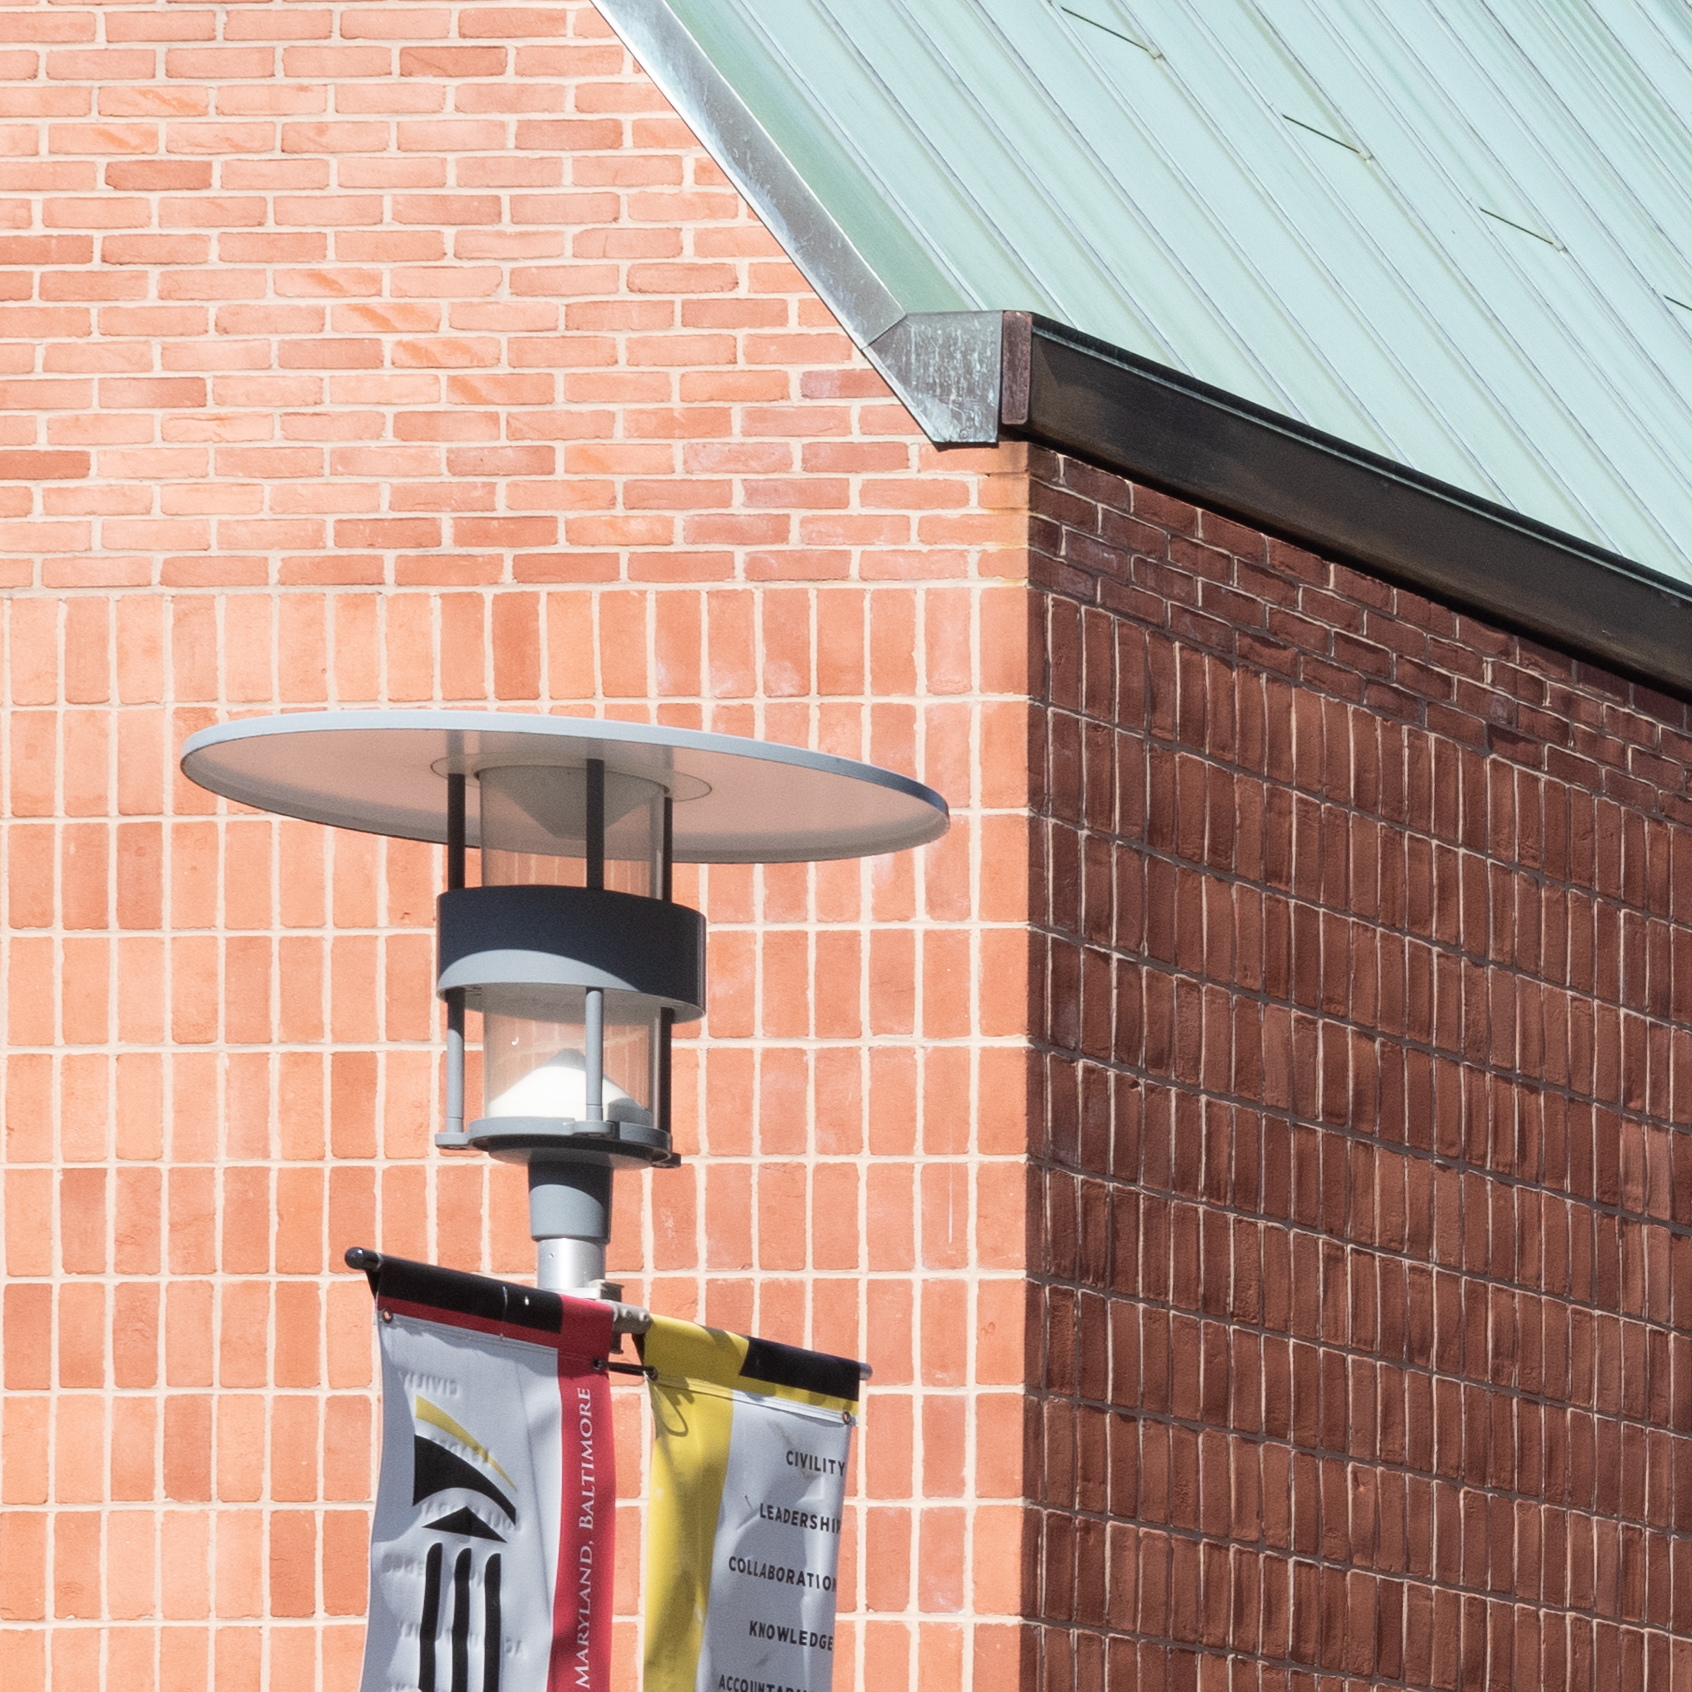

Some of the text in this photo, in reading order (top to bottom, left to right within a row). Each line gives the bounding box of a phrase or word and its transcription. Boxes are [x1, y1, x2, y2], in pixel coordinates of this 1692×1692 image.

[577, 1387, 595, 1529] BALTIMORE
[786, 1450, 846, 1477] CIVILITY
[575, 1541, 593, 1689] MARYLAND,
[748, 1620, 834, 1651] KNOWLEDGE
